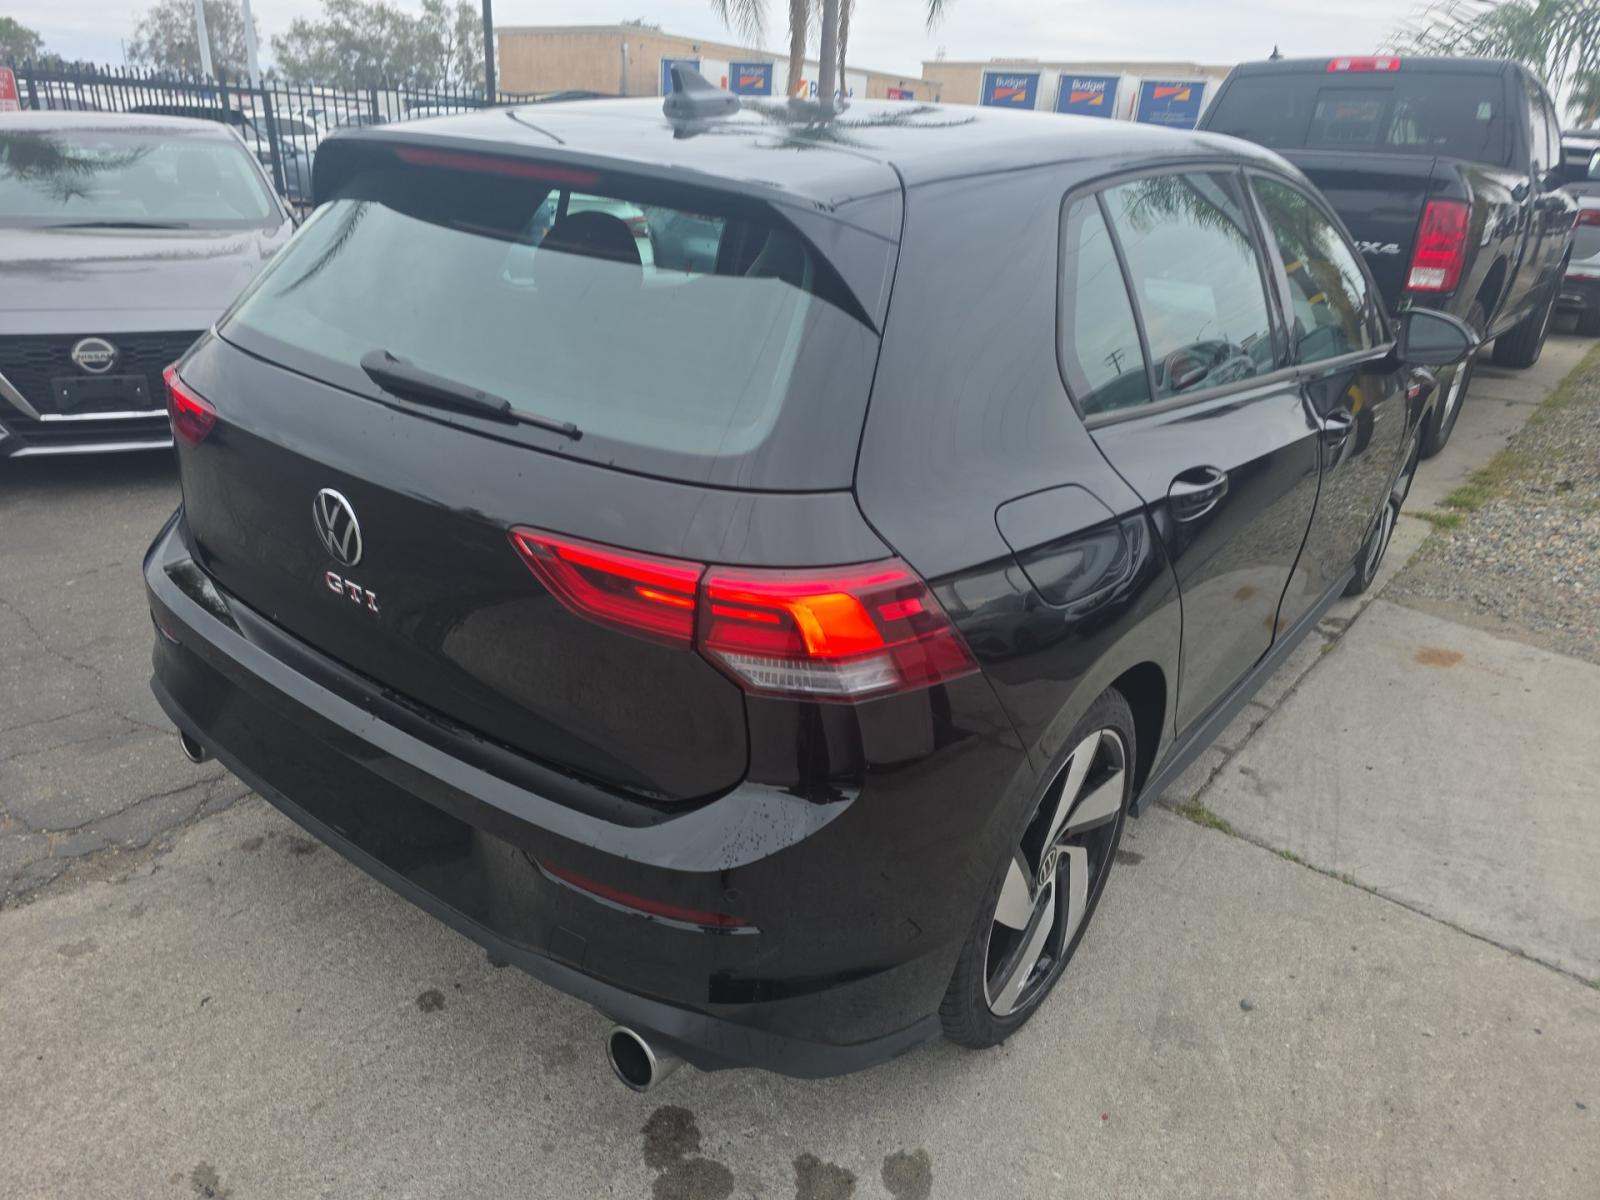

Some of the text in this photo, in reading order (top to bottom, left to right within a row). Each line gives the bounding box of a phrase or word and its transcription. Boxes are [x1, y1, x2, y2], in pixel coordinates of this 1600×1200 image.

[996, 77, 1029, 89] Budget
[1072, 79, 1105, 92] Budget
[324, 570, 380, 614] GTI
